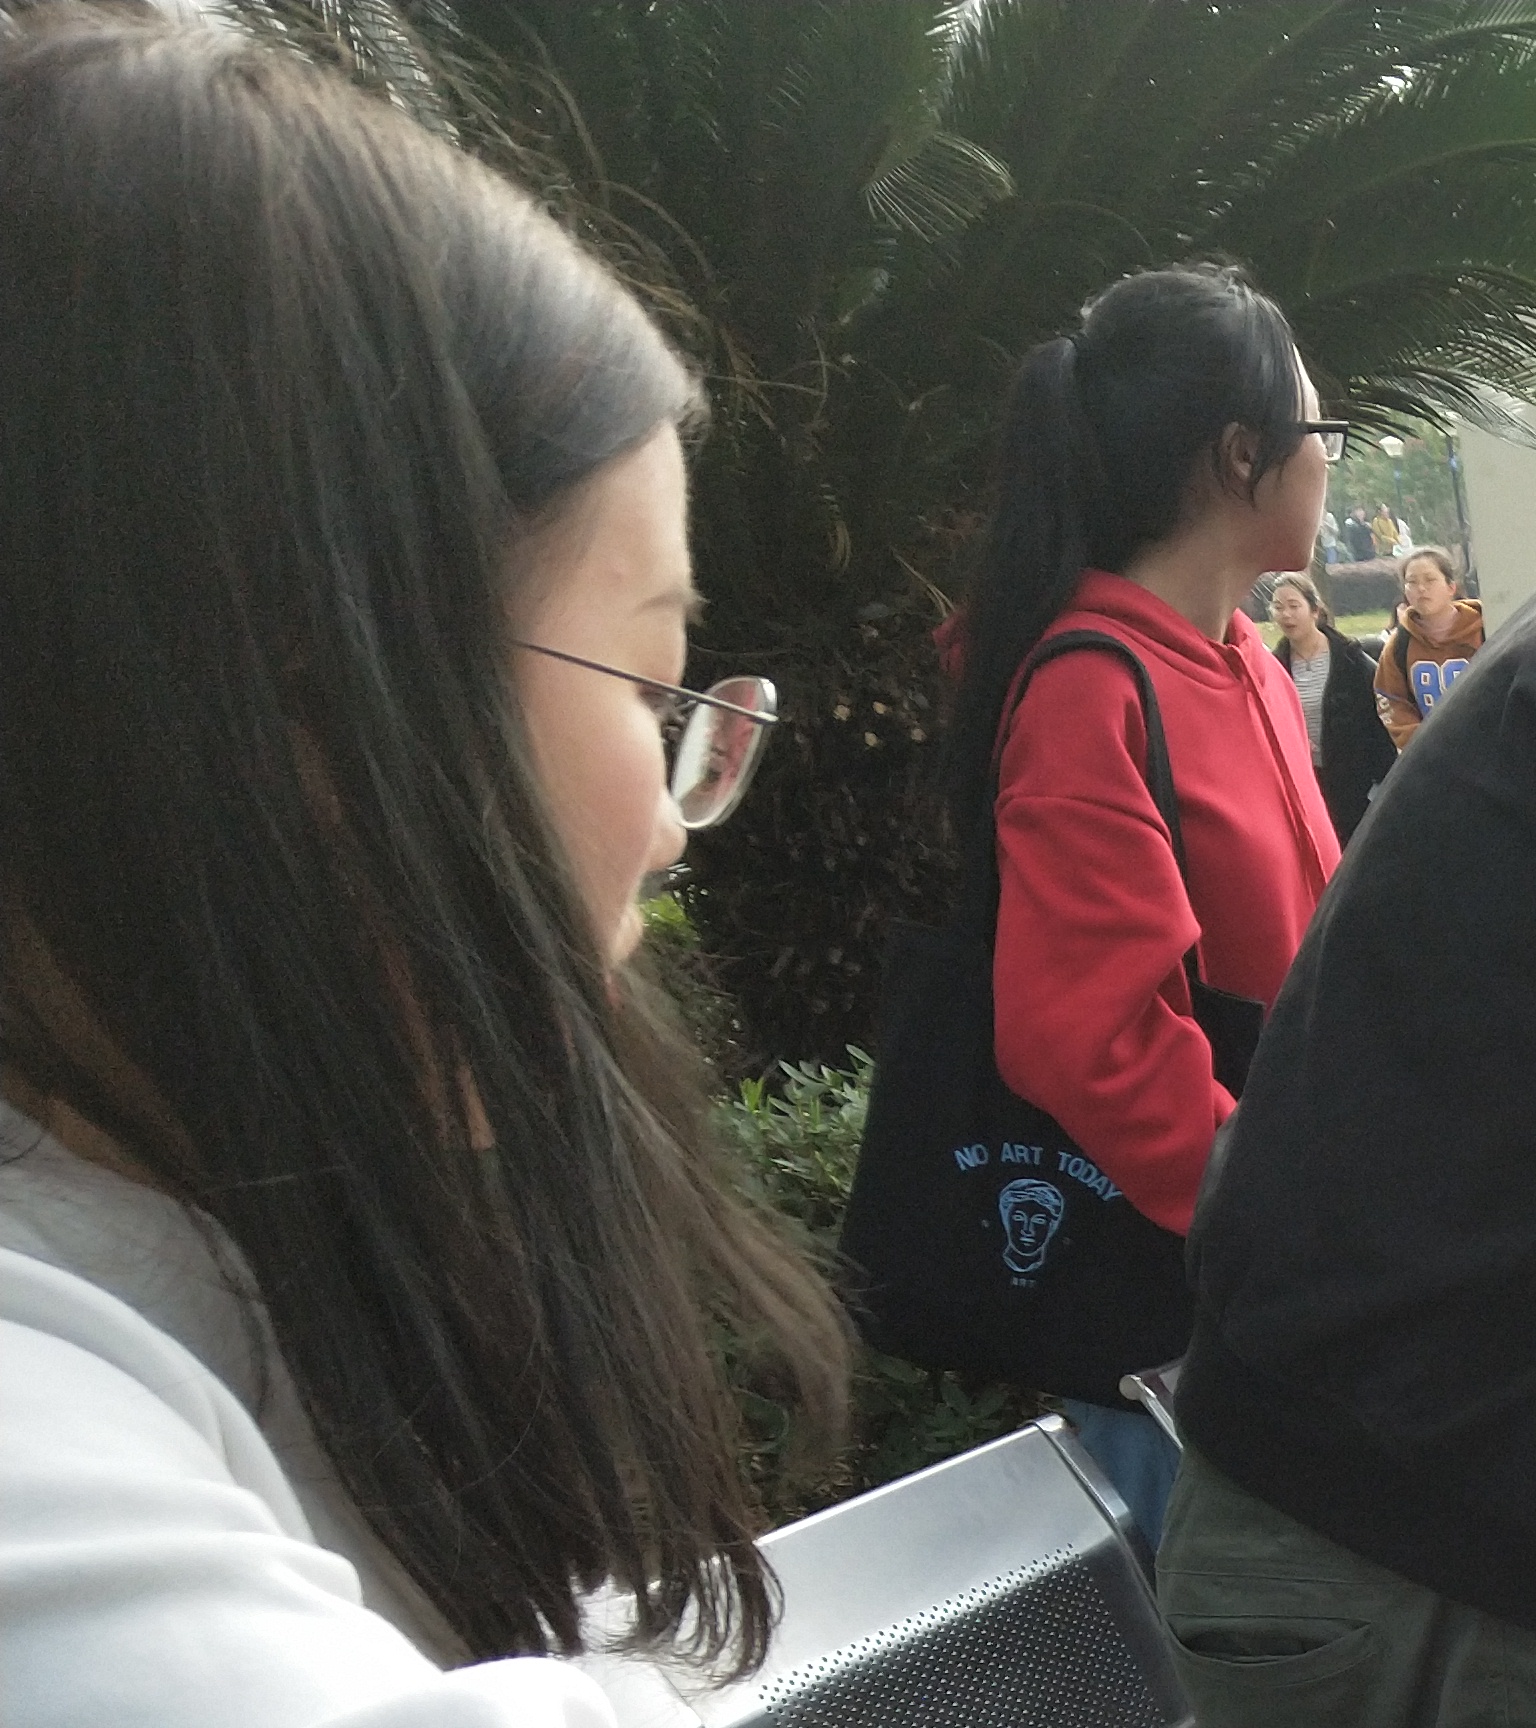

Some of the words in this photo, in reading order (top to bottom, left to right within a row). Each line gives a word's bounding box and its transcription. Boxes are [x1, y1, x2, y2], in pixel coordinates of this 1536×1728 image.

[955, 1144, 989, 1171] NO
[1001, 1142, 1043, 1165] ART
[1057, 1151, 1123, 1202] TODAY
